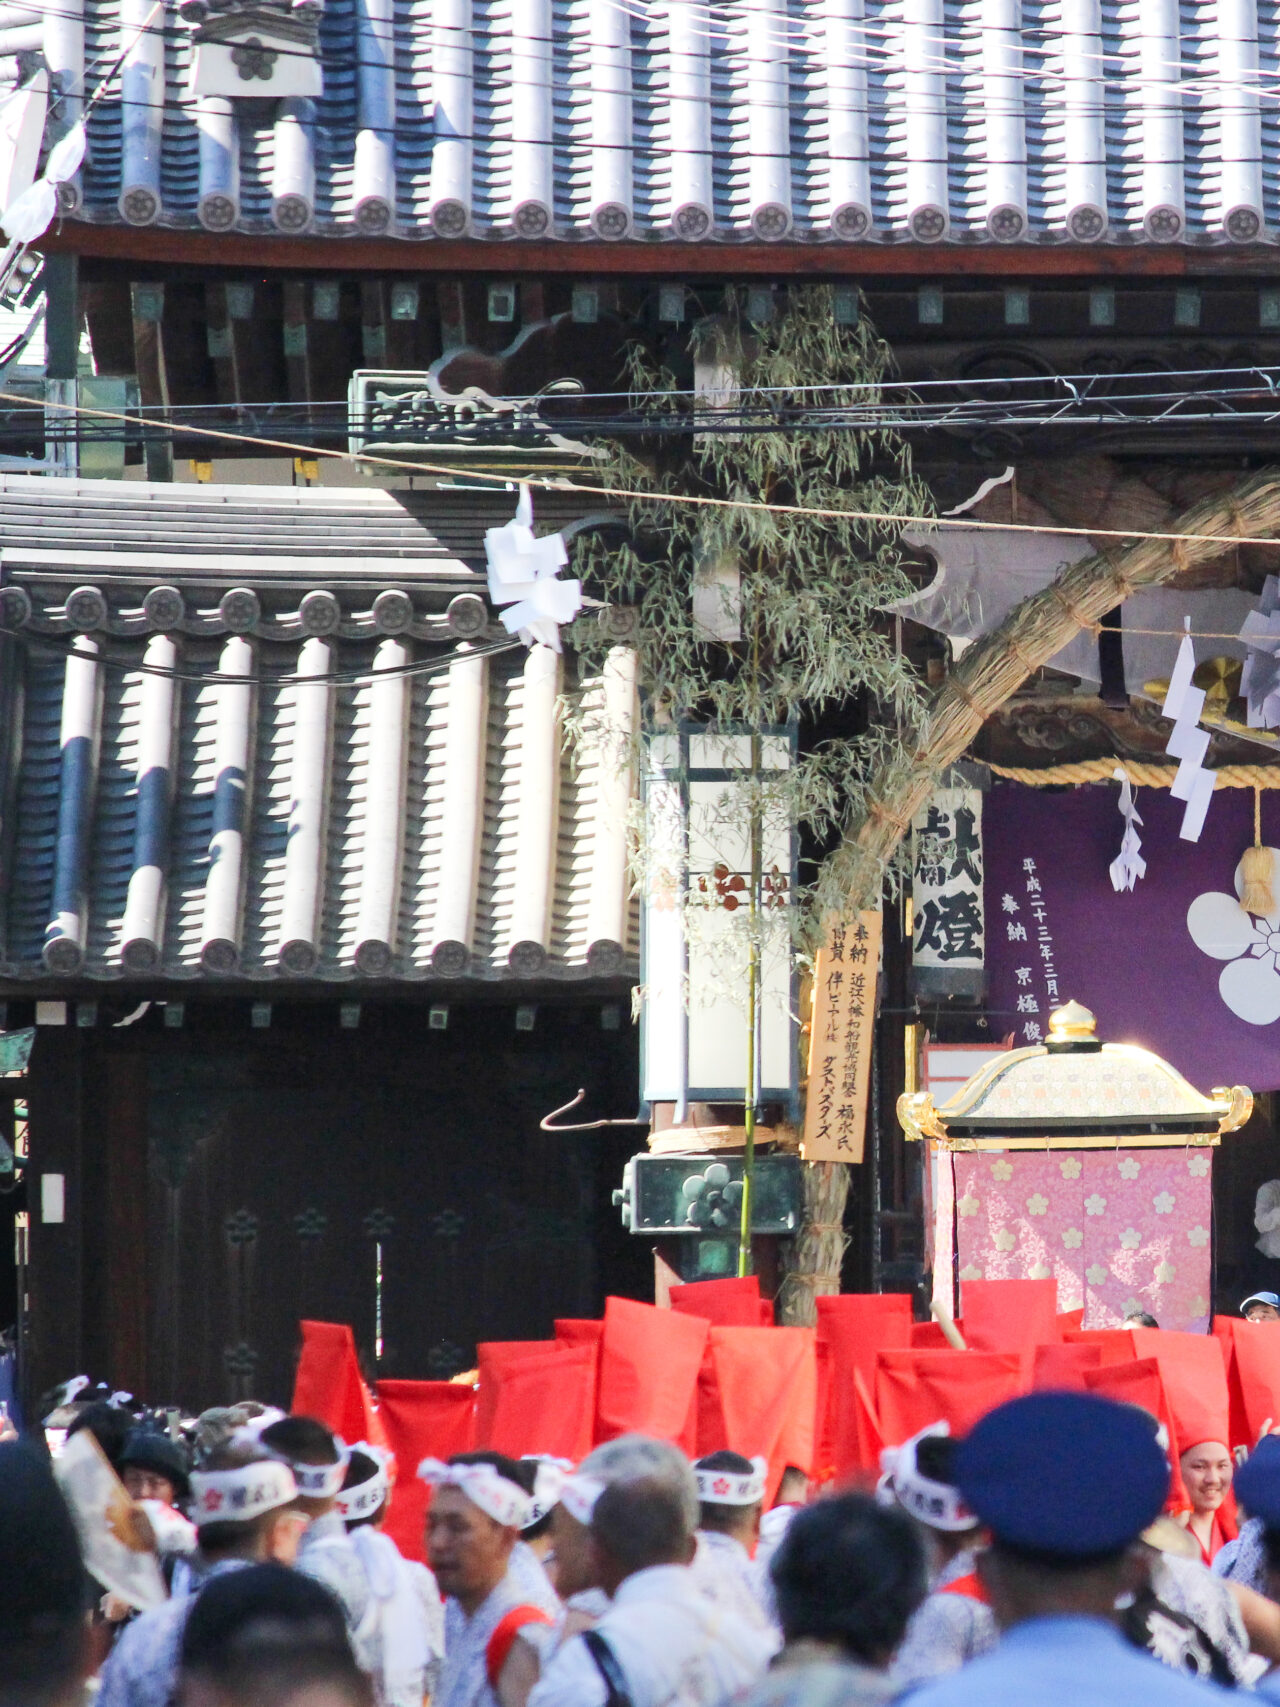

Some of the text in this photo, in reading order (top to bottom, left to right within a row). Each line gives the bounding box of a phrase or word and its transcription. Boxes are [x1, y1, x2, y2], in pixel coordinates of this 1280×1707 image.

[849, 922, 869, 964] 奉納
[1001, 893, 1044, 1046] 奉納 京極俊
